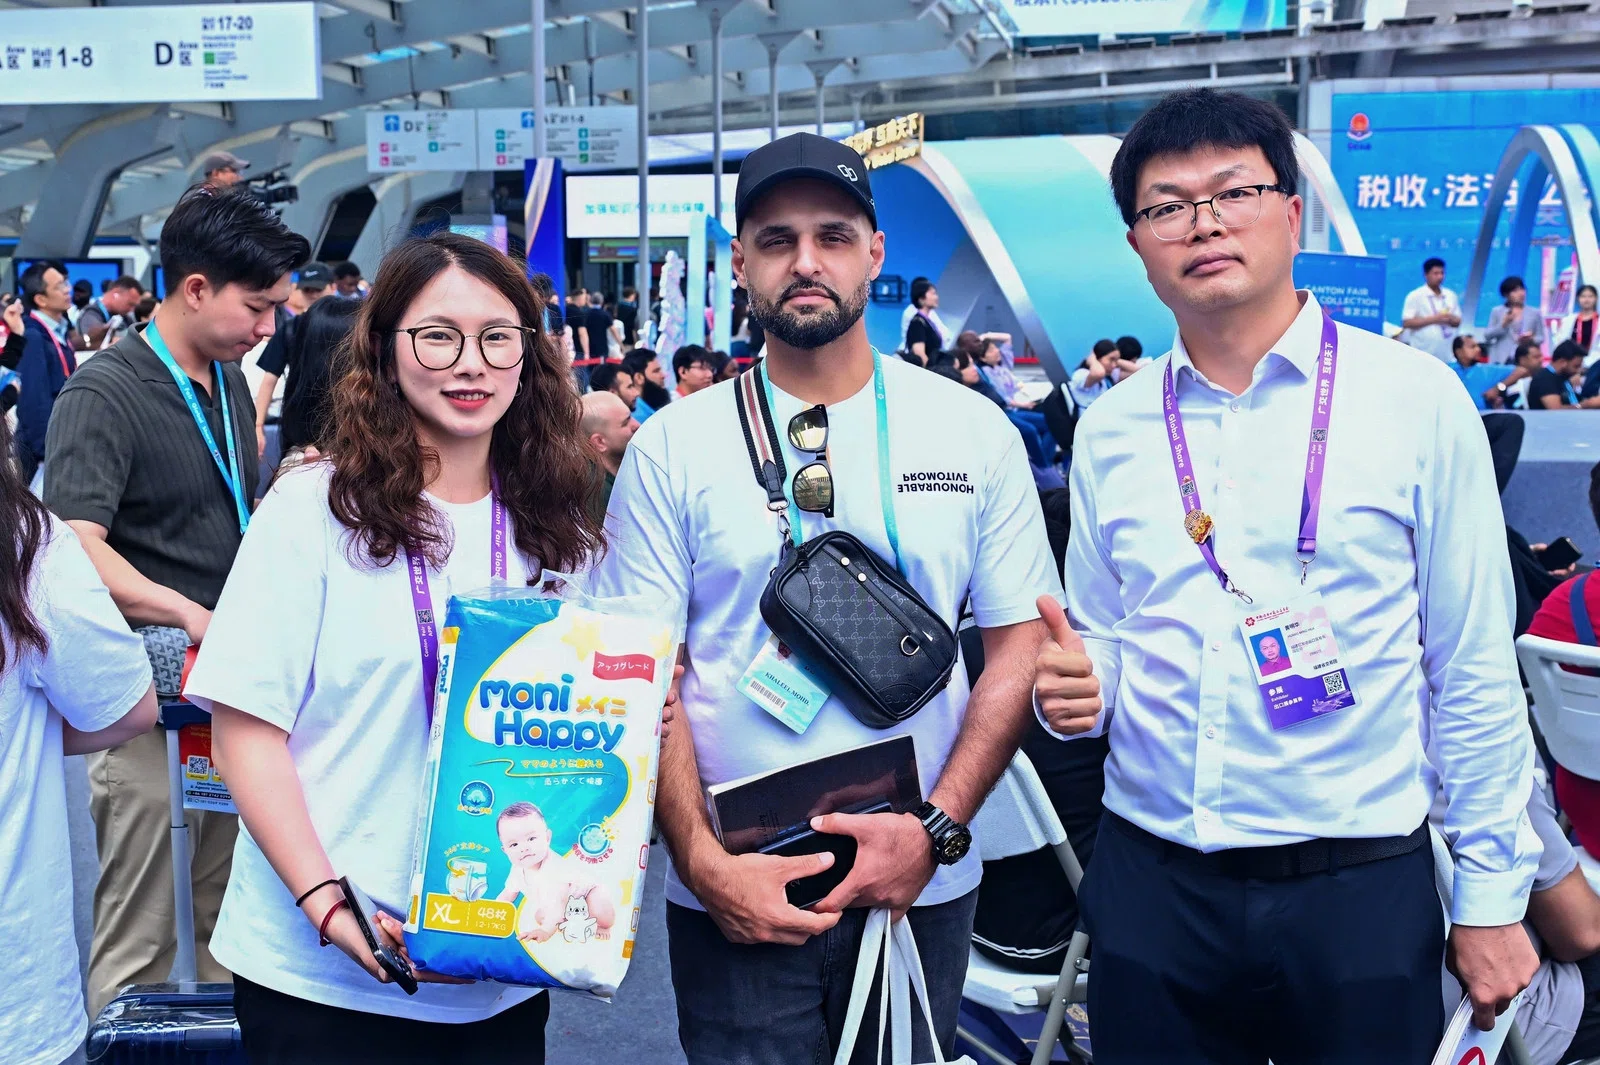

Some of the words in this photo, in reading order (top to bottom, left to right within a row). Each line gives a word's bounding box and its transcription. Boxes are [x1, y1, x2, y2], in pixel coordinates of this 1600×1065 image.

[217, 16, 253, 30] 17-20
[58, 47, 93, 67] 1-8
[155, 42, 173, 65] D
[404, 121, 413, 132] D
[1168, 413, 1180, 441] Global
[1174, 443, 1184, 468] Share
[897, 483, 974, 494] HONOURABLE
[440, 655, 449, 693] moni
[765, 672, 791, 693] KHALEEL
[480, 674, 575, 713] moni
[494, 711, 625, 752] Happy
[431, 902, 460, 924] XL
